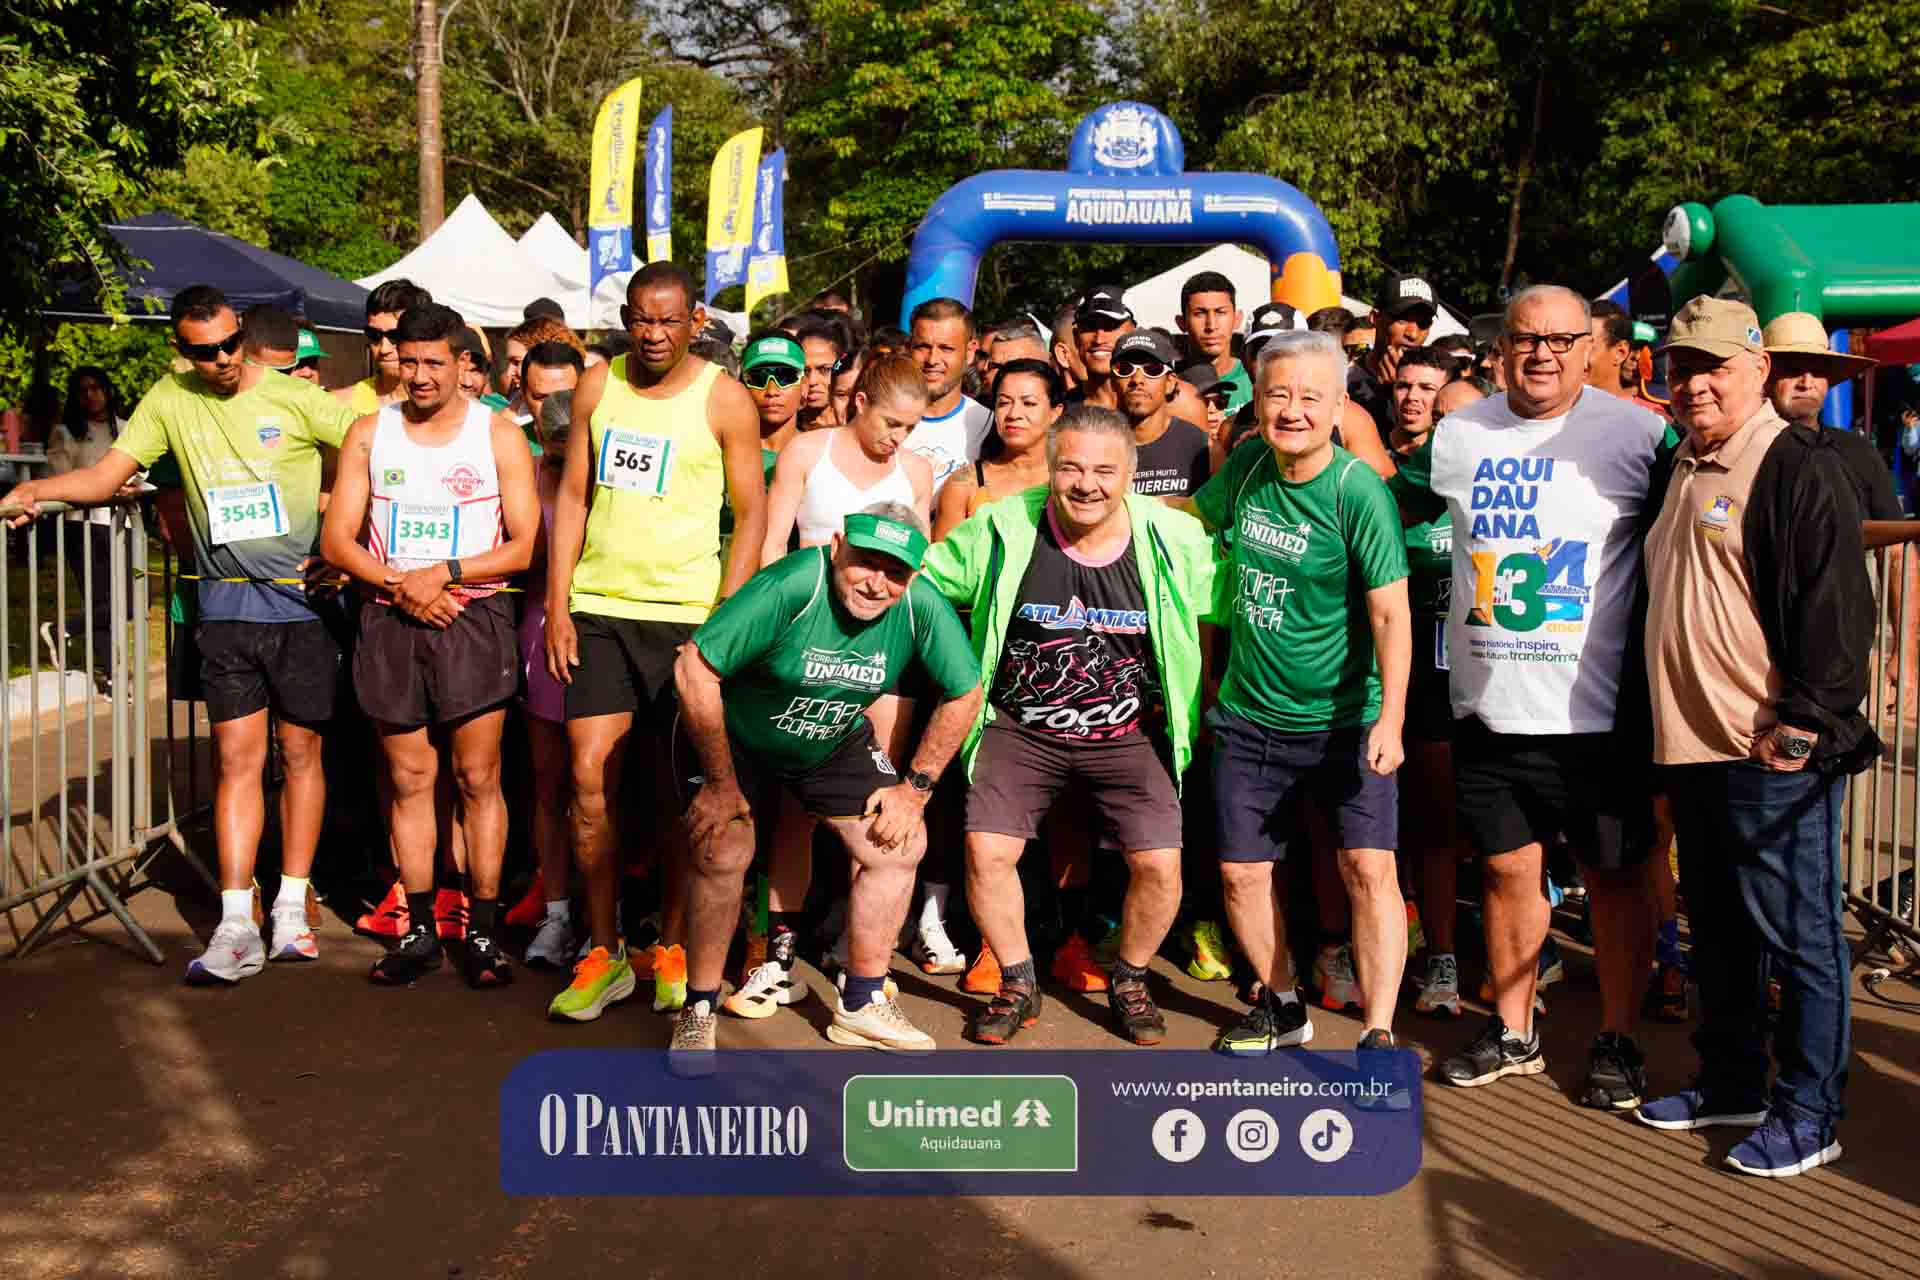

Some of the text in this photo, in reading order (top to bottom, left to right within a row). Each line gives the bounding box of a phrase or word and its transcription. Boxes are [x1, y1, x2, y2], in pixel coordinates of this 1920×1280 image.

[1066, 200, 1192, 226] AQUIDAUANA
[613, 448, 653, 472] 565
[1473, 457, 1554, 485] AQUI
[1471, 486, 1538, 510] DAU
[220, 502, 271, 523] 3543
[400, 520, 450, 539] 3343
[1241, 519, 1308, 555] UNIMED
[1471, 514, 1541, 539] ANA
[1515, 637, 1560, 653] inspira,
[804, 660, 887, 684] UNIMED
[769, 696, 865, 724] BORA
[1019, 697, 1140, 729] FOCO
